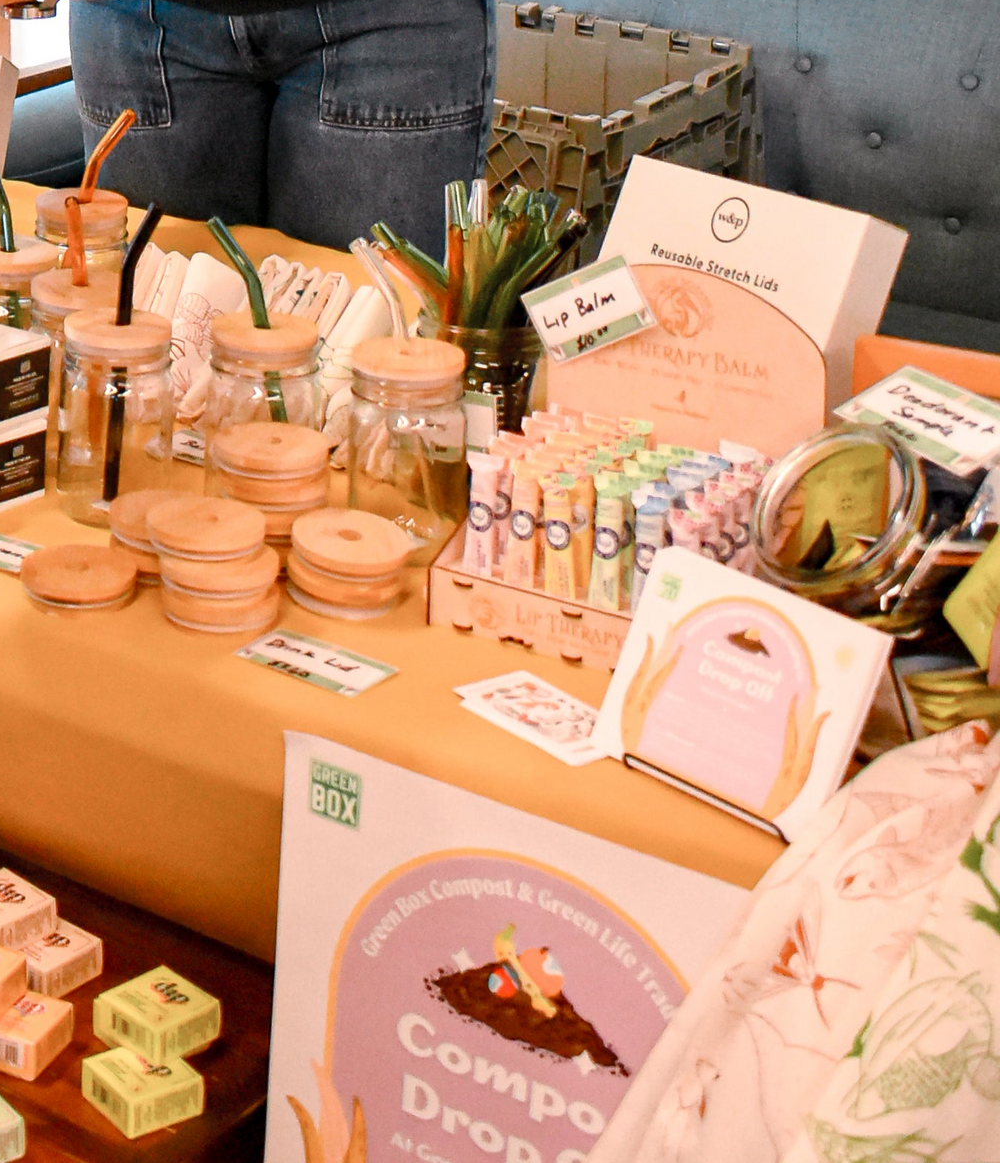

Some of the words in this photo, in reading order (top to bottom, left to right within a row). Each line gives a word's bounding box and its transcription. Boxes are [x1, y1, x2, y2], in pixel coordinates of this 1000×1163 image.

[718, 212, 743, 229] w&p
[650, 243, 704, 269] Reusable
[706, 260, 750, 283] Stretch
[754, 274, 779, 292] Lids
[575, 292, 615, 317] Balm
[698, 659, 744, 692] Drop
[703, 639, 782, 685] Compost
[312, 764, 358, 793] GREEN
[311, 782, 357, 824] BOX
[361, 906, 404, 958] Green
[396, 888, 431, 917] Box
[429, 877, 513, 901] Compost
[517, 881, 535, 904] &
[537, 891, 600, 942] Green
[599, 927, 638, 974] Life
